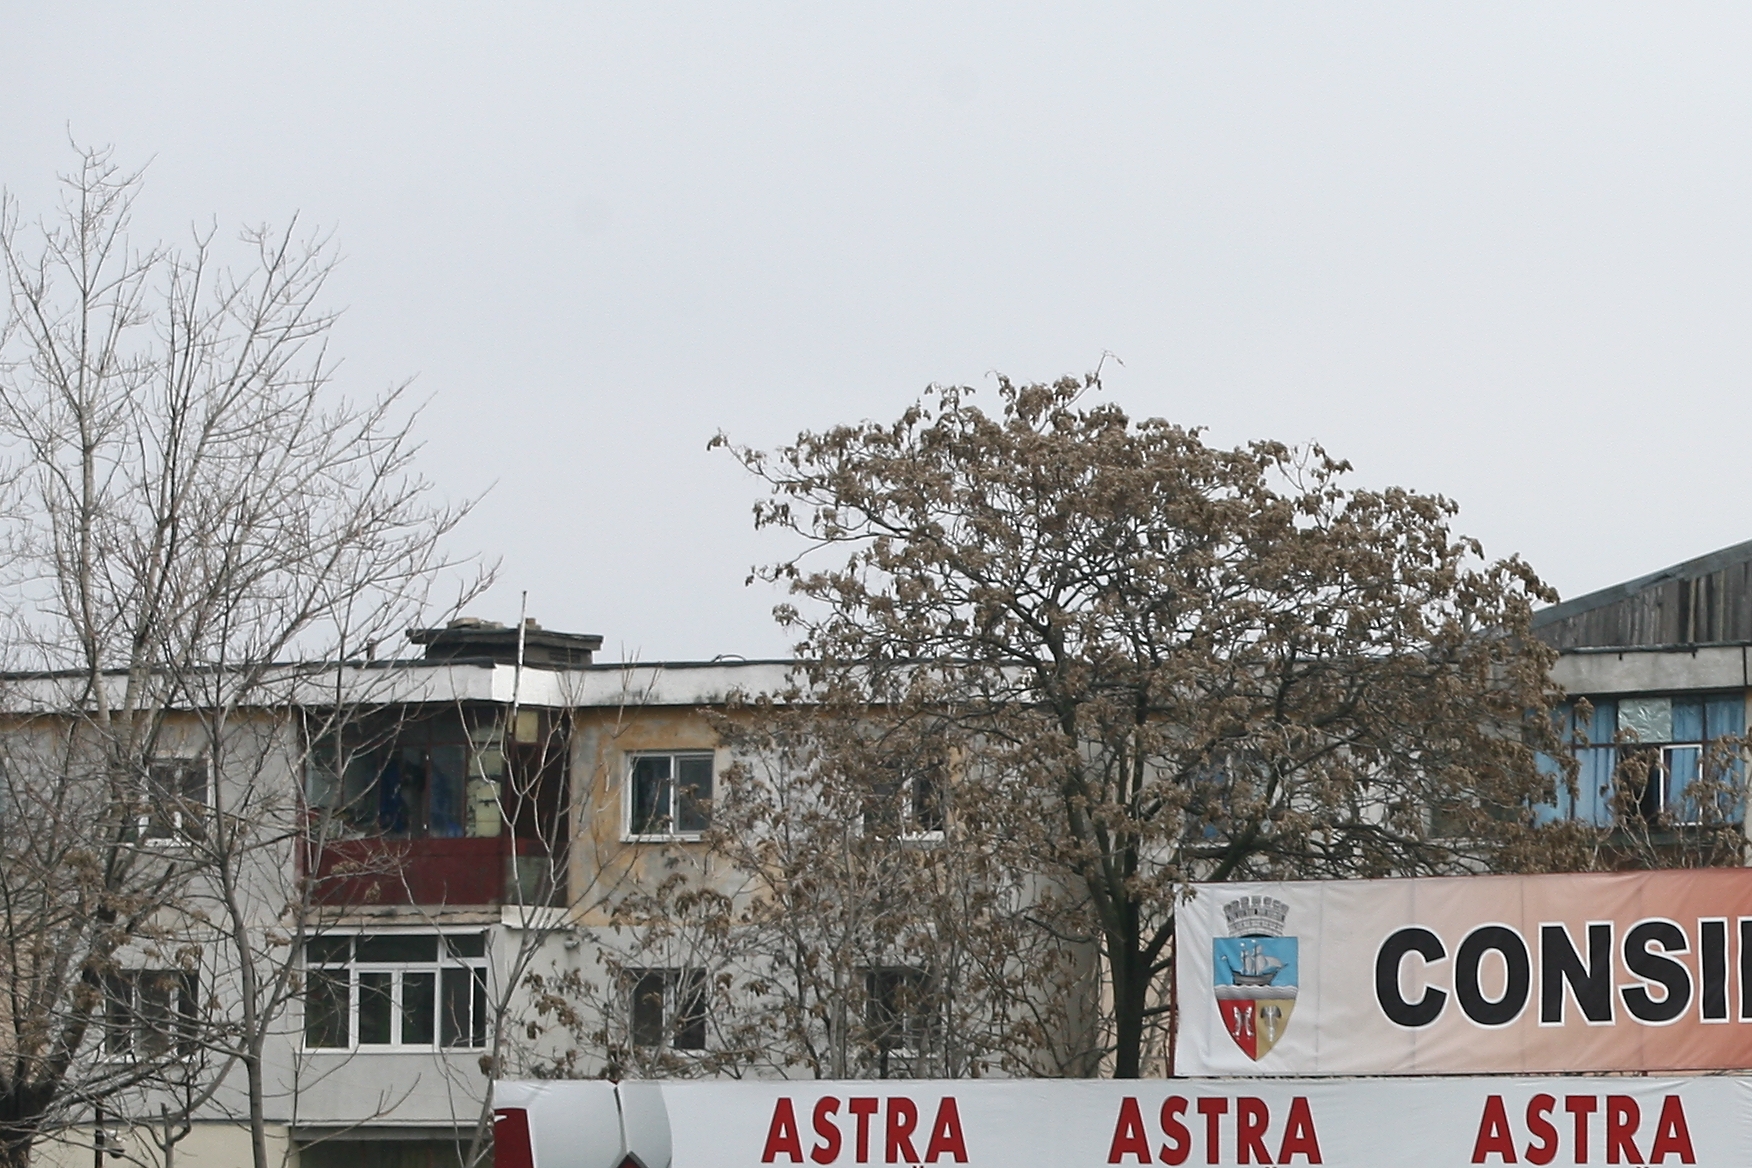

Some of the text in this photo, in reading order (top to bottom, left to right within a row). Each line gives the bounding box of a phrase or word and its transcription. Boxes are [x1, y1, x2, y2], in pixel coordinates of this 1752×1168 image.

[763, 1096, 968, 1164] ASTRA
[1109, 1096, 1321, 1166] ASTRA
[1472, 1094, 1695, 1166] ASTRA
